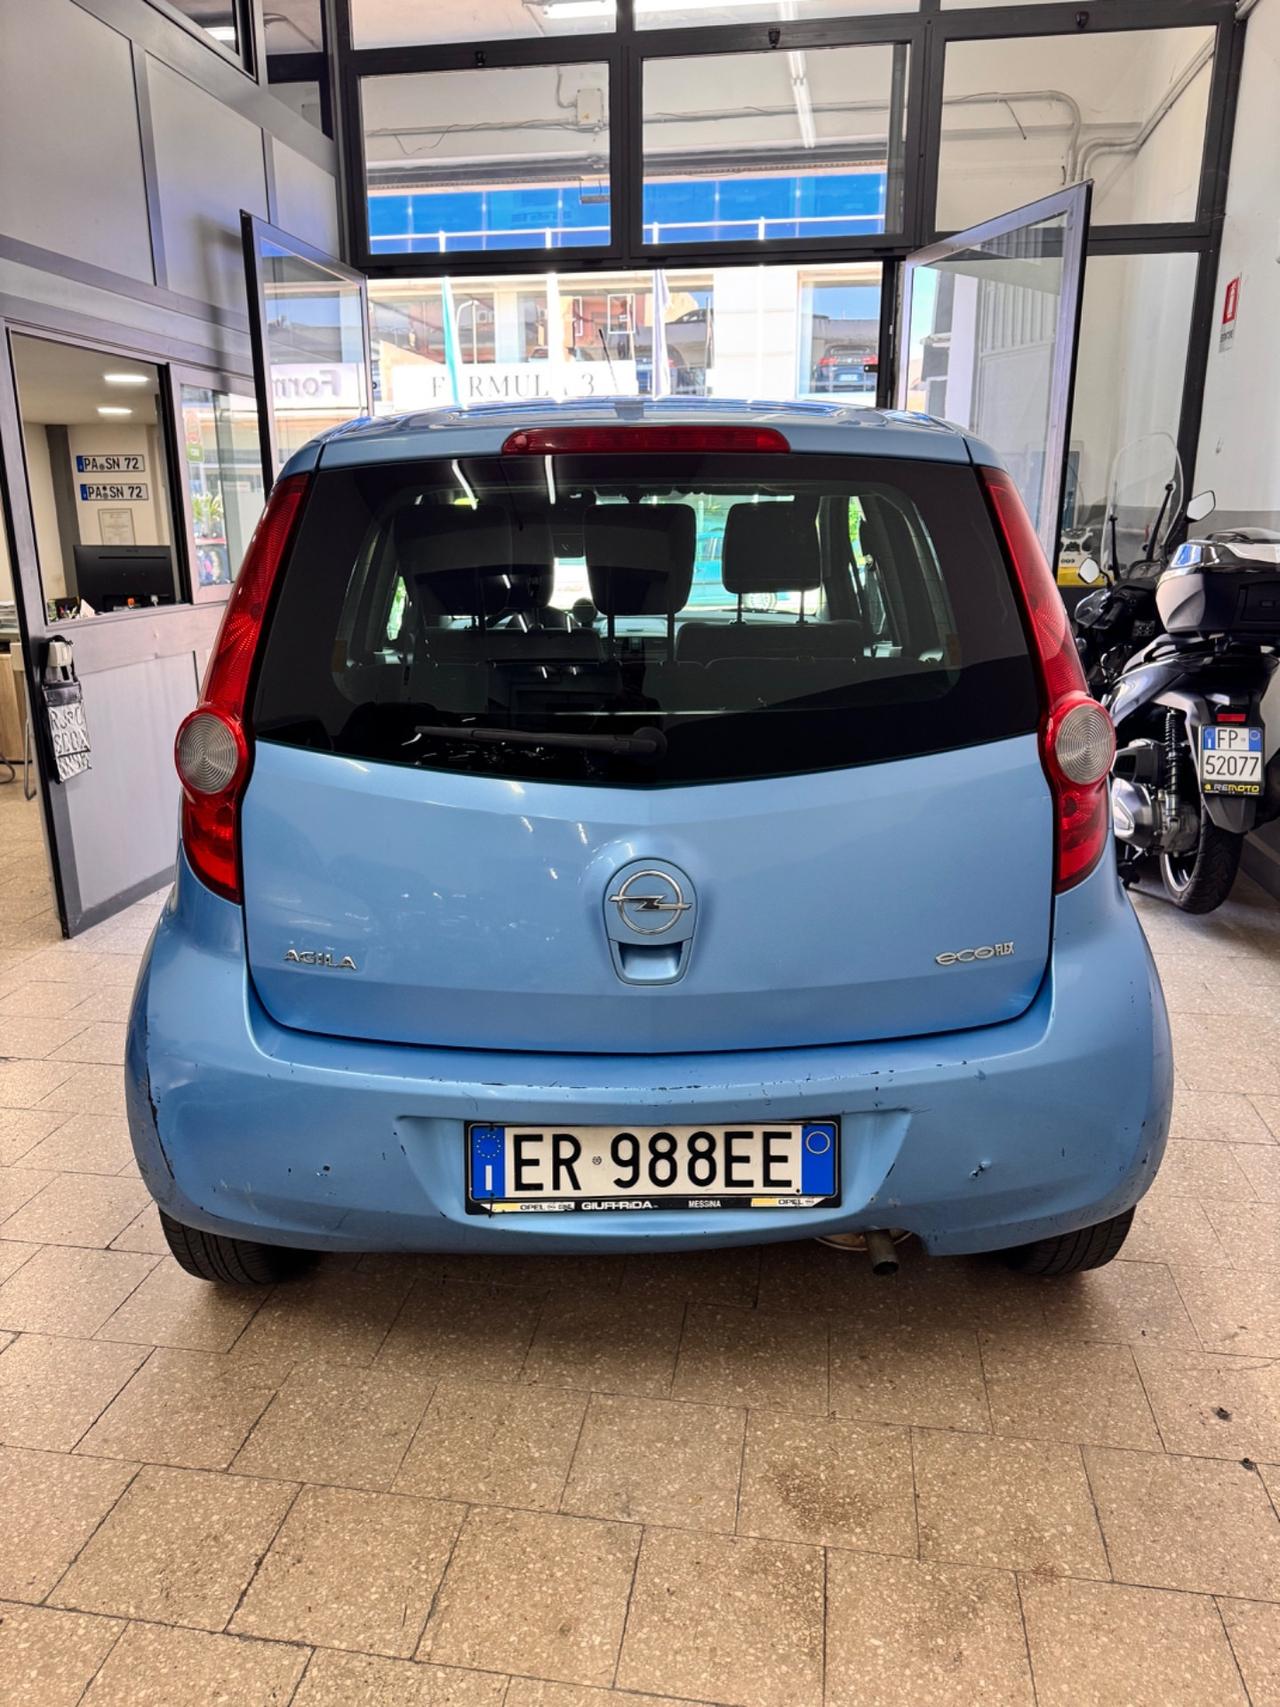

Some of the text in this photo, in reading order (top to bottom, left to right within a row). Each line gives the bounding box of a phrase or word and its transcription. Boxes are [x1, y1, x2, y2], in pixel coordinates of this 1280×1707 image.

[581, 373, 595, 397] 3
[84, 457, 139, 470] PA SN 72
[88, 486, 142, 499] PA SN 72
[1217, 729, 1239, 749] FP
[1205, 755, 1260, 777] 52077
[283, 949, 357, 970] AGILA
[513, 1131, 793, 1192] ER 988EE
[688, 1200, 721, 1208] MESSINA
